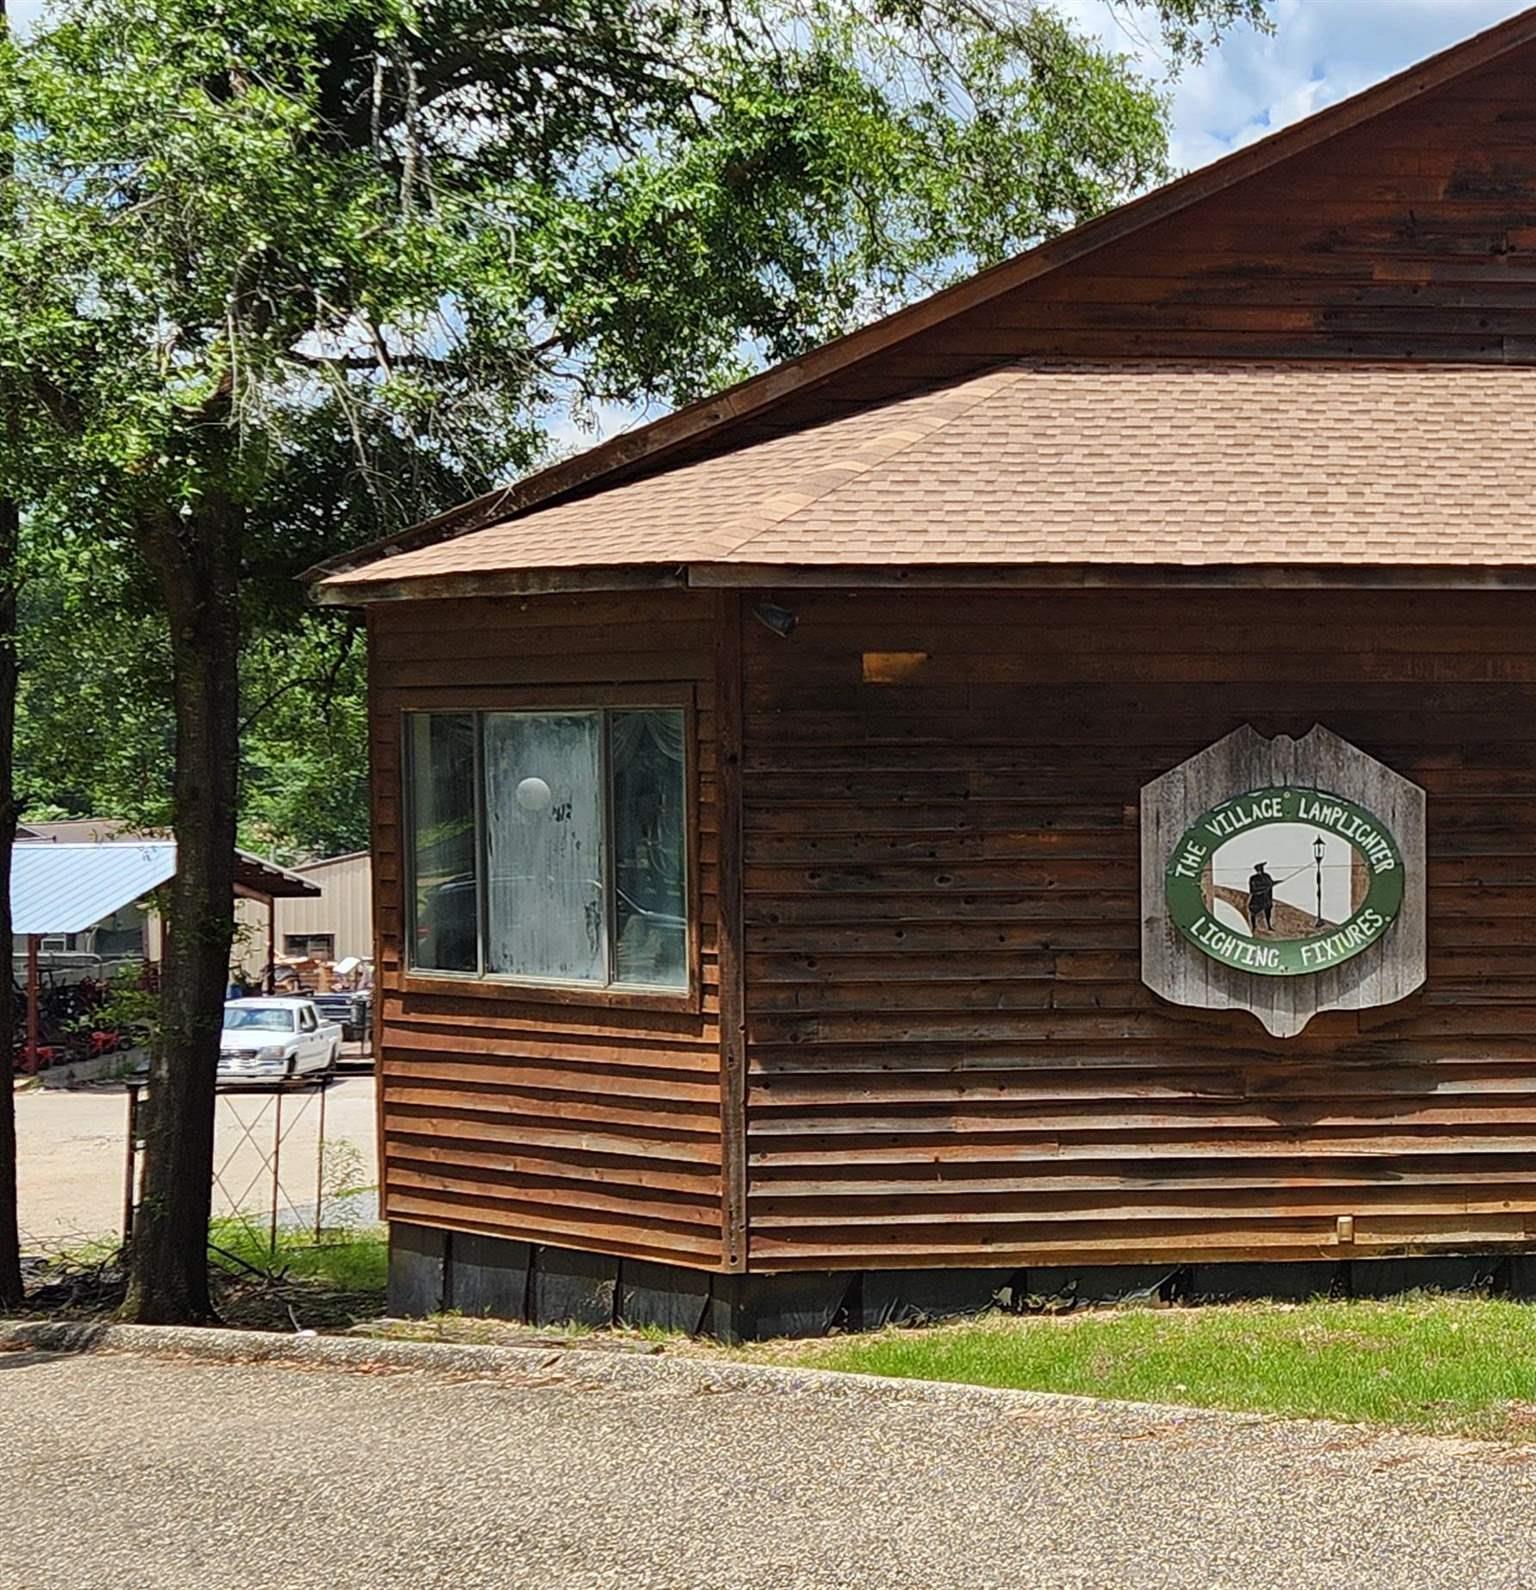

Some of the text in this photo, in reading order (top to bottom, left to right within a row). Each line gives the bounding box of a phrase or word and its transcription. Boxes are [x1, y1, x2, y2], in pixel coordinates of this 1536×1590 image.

[1174, 797, 1396, 878] THE VILLAGE LAMPLIGHTER
